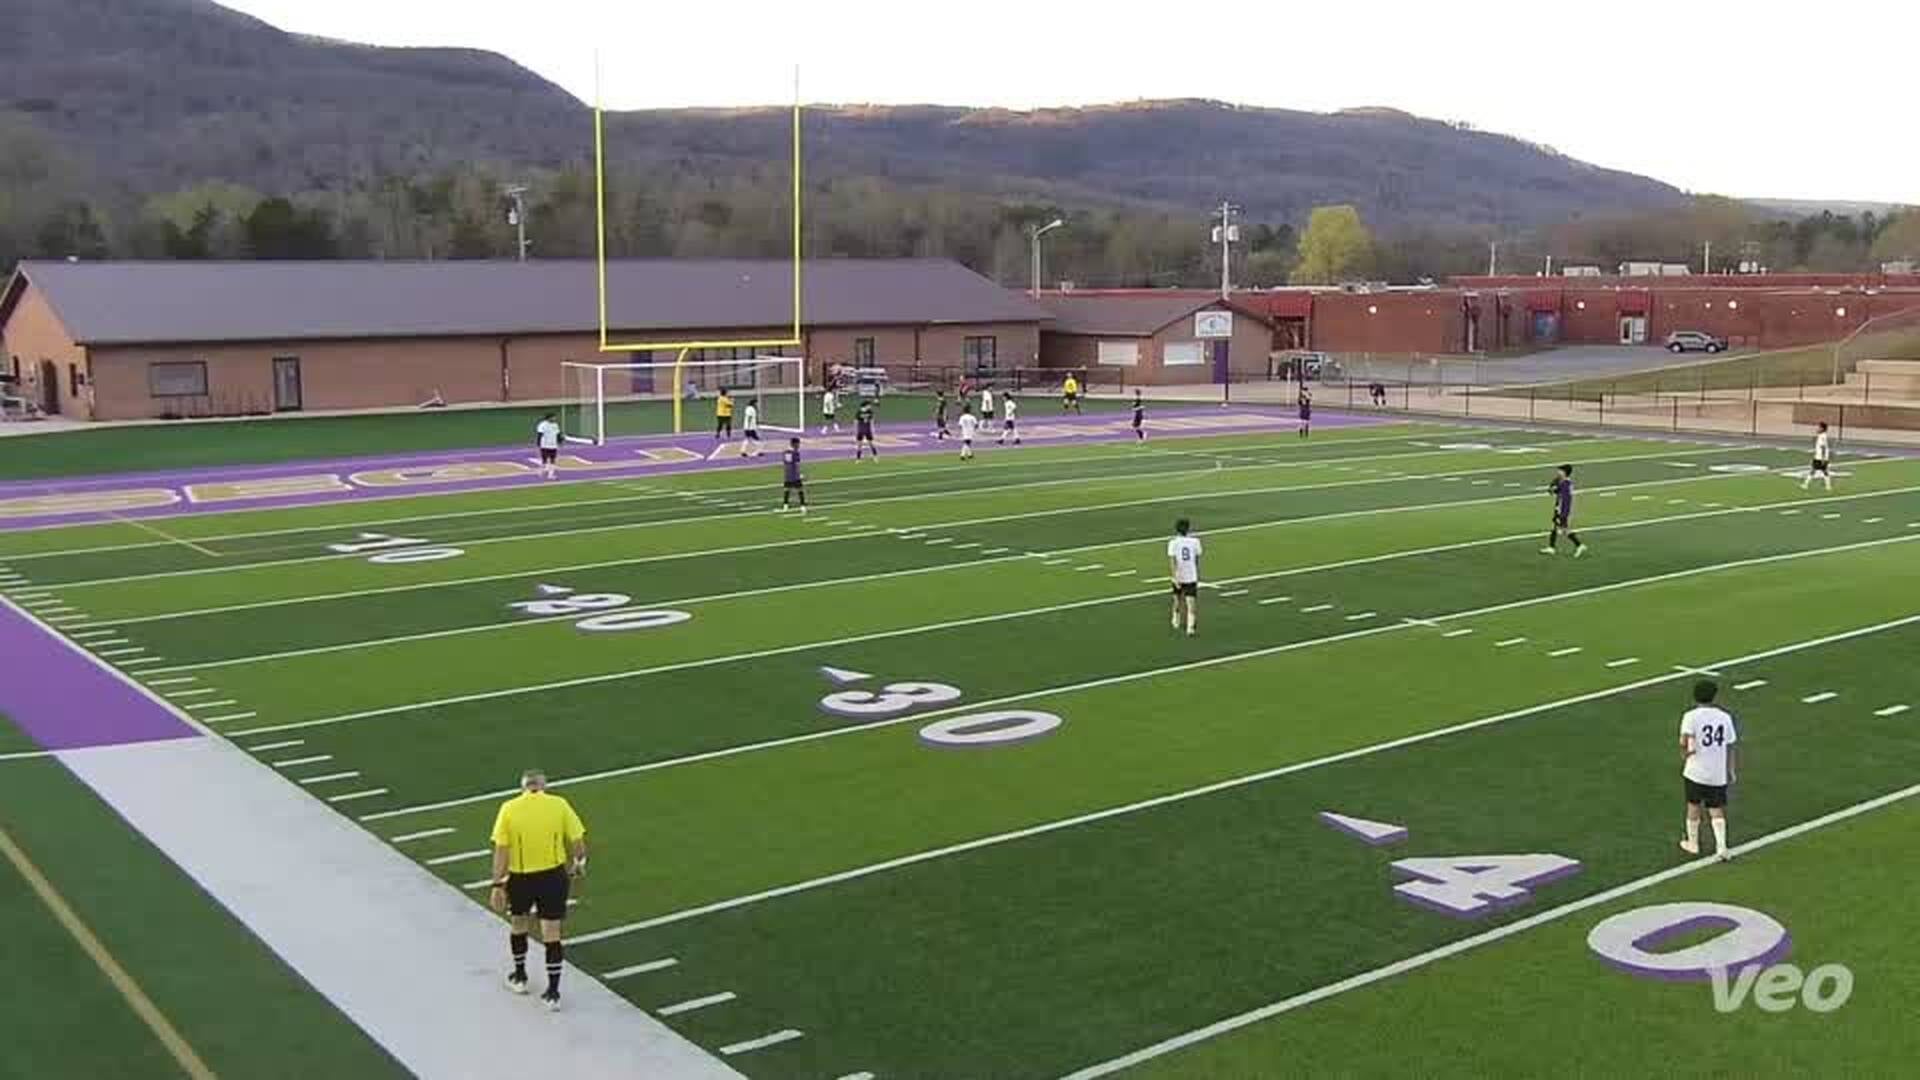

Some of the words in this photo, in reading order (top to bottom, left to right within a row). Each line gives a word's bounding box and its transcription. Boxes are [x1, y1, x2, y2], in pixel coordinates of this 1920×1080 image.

[508, 592, 693, 632] 20
[821, 682, 1064, 744] 30
[1702, 724, 1725, 747] 34
[1391, 853, 1790, 976] 40
